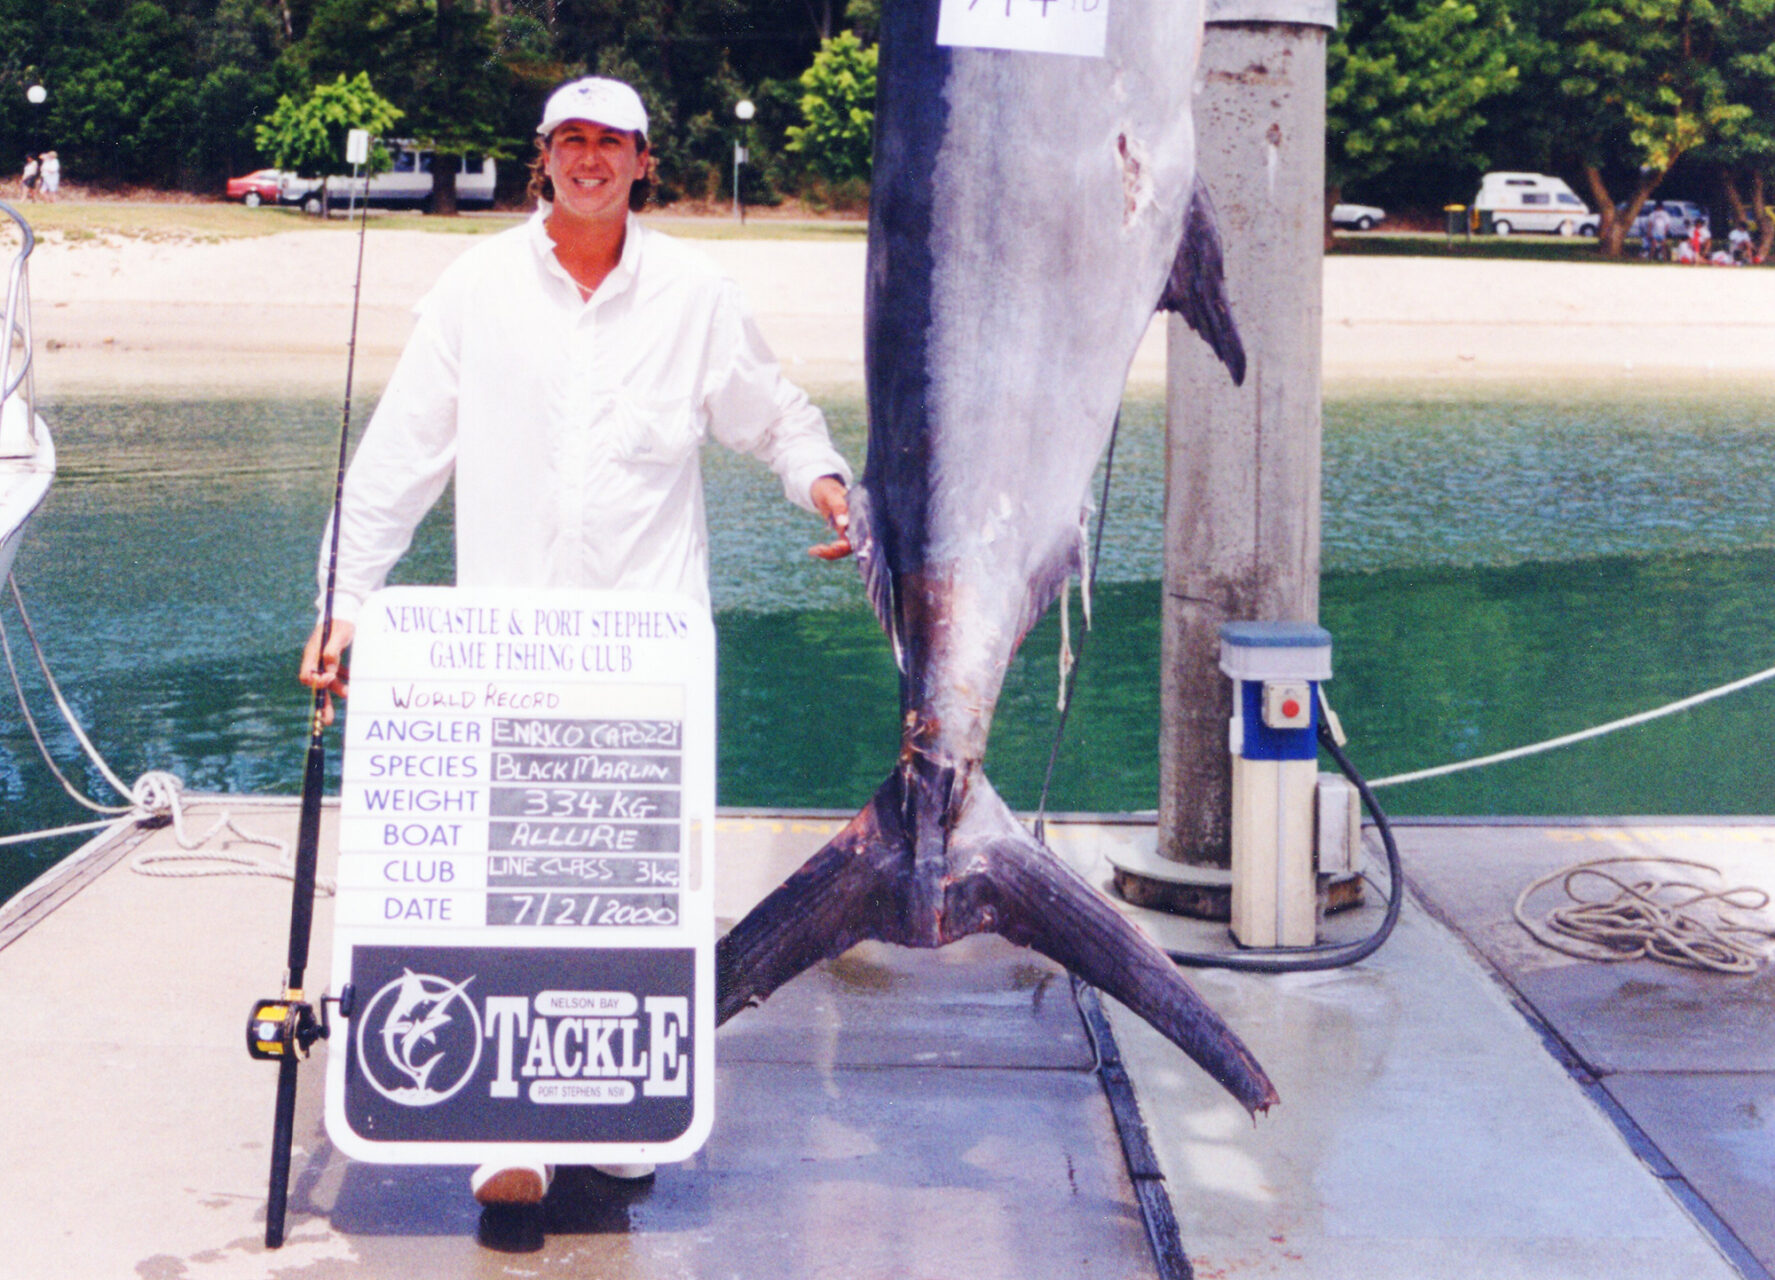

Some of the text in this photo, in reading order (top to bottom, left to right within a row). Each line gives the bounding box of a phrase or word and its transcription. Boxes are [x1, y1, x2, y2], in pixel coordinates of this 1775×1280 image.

[384, 605, 688, 639] NEWCASTLE & PORT STEPHENS
[430, 641, 633, 672] GAME FISHING CLUB
[365, 720, 481, 742] ANGLER
[493, 718, 584, 747] ENRICO
[369, 755, 478, 777] SPECIES
[496, 756, 670, 781] BLACK MARLIN
[364, 789, 479, 812] WEIGHT
[523, 789, 603, 816] 334
[383, 824, 462, 847] BOAT
[510, 822, 638, 850] ALLURE
[383, 860, 455, 883] CLUB
[488, 856, 537, 878] LINE
[539, 857, 613, 880] CLASS
[384, 897, 452, 920] DATE
[550, 997, 620, 1009] NELSON BAY
[484, 995, 688, 1098] TACKLE
[538, 1086, 626, 1098] PORT STEPHENS NSW
